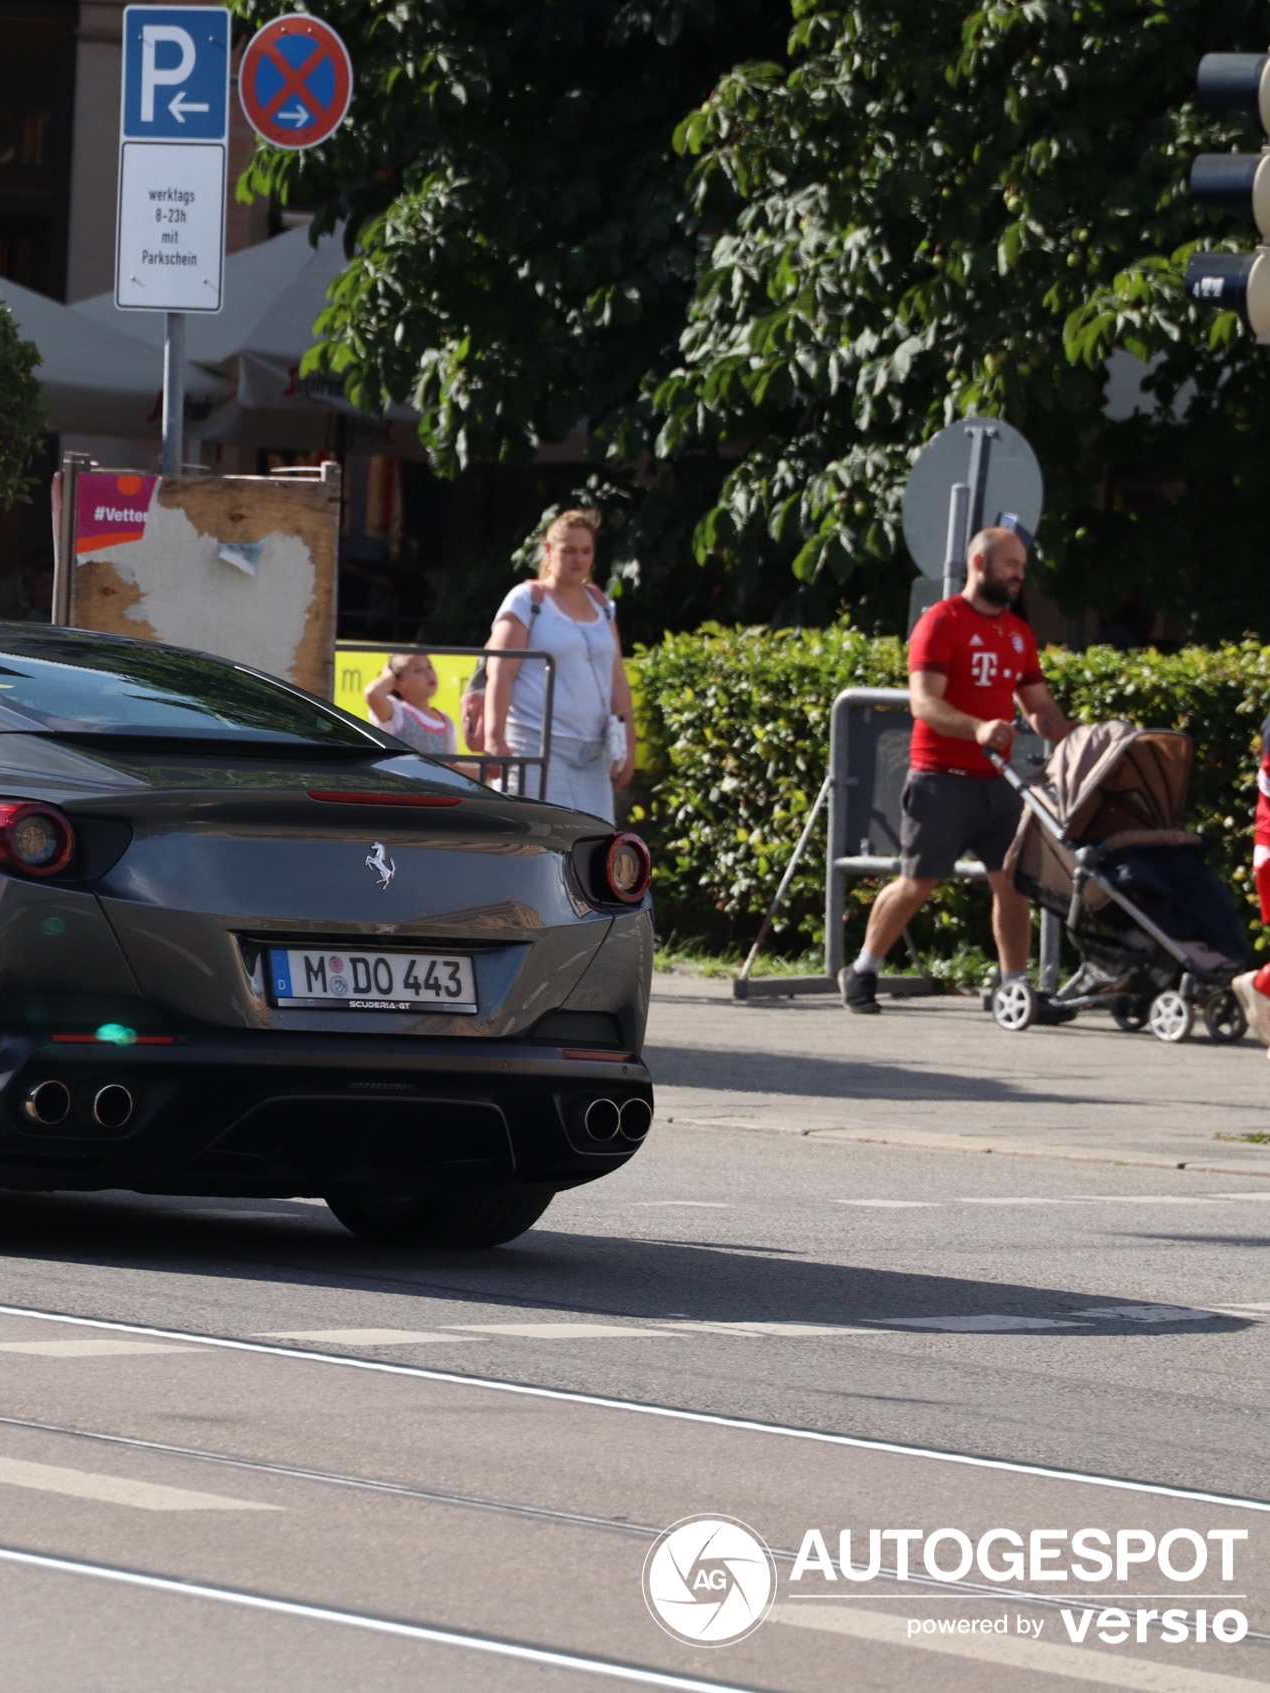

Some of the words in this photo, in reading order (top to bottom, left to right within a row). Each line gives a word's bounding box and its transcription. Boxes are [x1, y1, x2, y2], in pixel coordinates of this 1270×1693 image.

[141, 25, 196, 122] P
[148, 187, 196, 206] werktags
[155, 208, 187, 223] 8-23h
[161, 230, 179, 245] mit
[141, 249, 198, 266] Parkschein
[304, 956, 328, 993] M
[349, 957, 393, 995] DO
[403, 959, 462, 997] 443
[349, 1000, 411, 1010] SCUDERIA-GT
